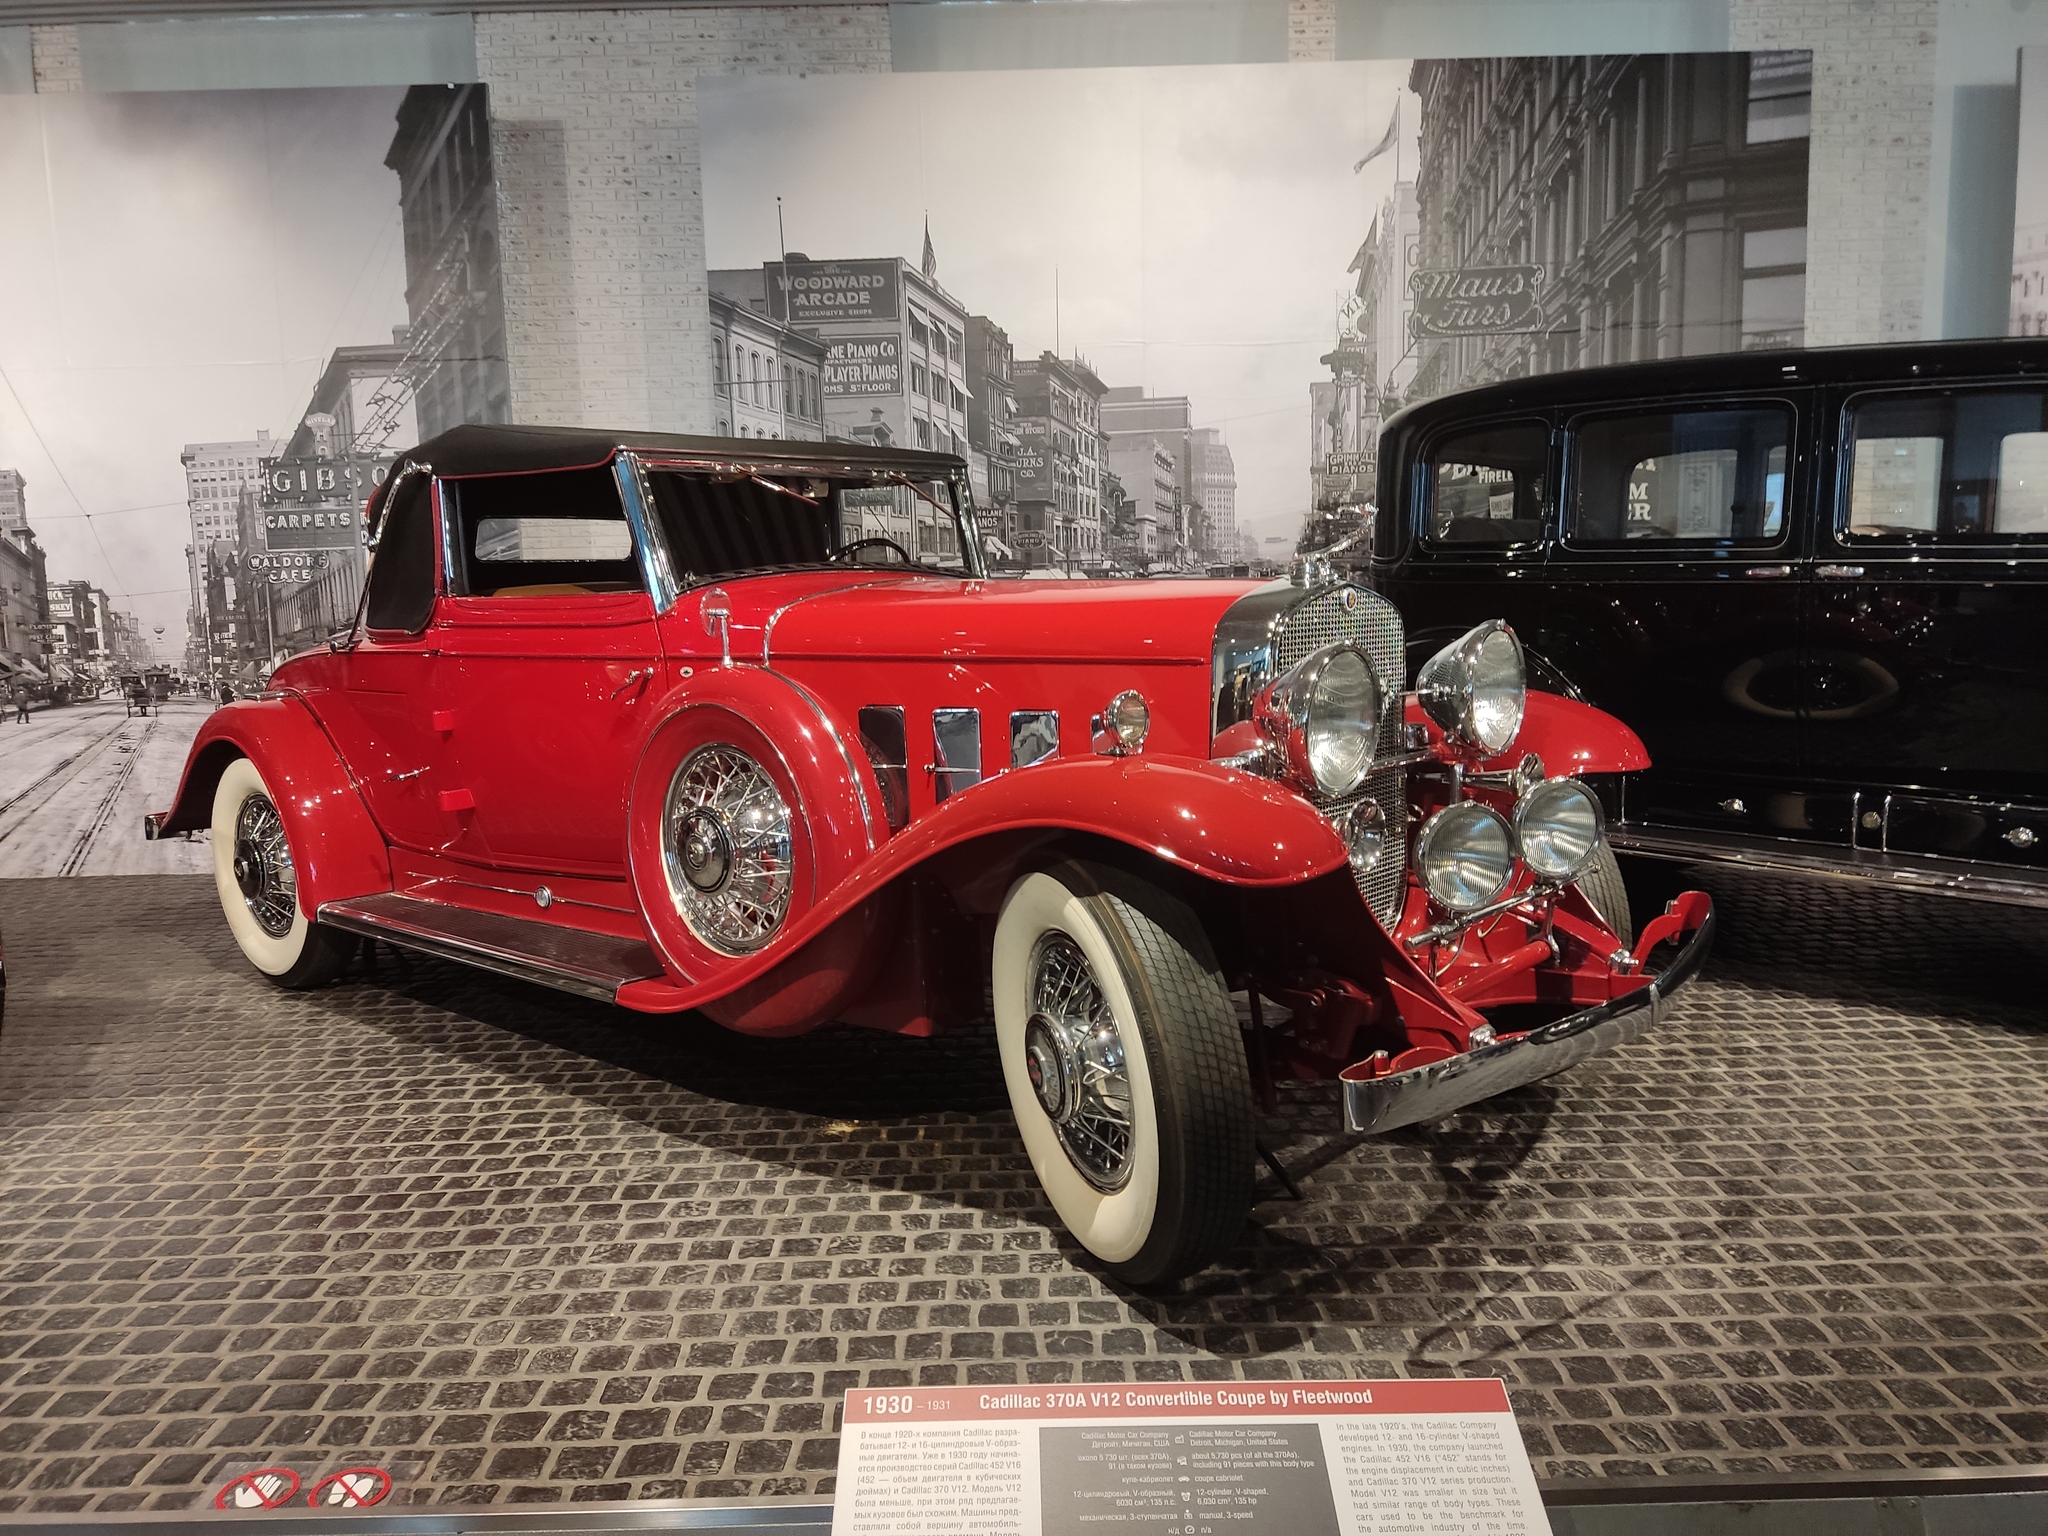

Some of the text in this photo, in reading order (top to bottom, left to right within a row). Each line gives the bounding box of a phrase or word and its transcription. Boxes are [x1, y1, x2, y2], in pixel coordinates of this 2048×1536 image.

[777, 275, 885, 290] WOODWARD
[793, 291, 871, 306] ARCADE
[799, 309, 844, 317] EXCLUSIVE
[847, 342, 879, 358] PIANO
[1332, 465, 1374, 474] PIANOS
[266, 513, 351, 529] CARPETS
[251, 556, 326, 568] WALDORF
[269, 569, 312, 580] CAFE
[863, 1396, 950, 1414] 1930 1931
[980, 1389, 1372, 1409] Cadillac 370A V12 Convertible Coupe by Fleetwood
[1346, 1423, 1360, 1431] the
[1361, 1422, 1377, 1430] late
[1410, 1422, 1424, 1430] the
[1426, 1421, 1458, 1430] Cadillac
[1459, 1420, 1497, 1431] Company
[861, 1428, 1021, 1440] В конце 1920-х компания Cadillac разра-
[1338, 1431, 1500, 1443] developed 12- and 16-cylinder V-shaped
[860, 1442, 896, 1450] батывает
[898, 1441, 910, 1449] 12-
[918, 1440, 985, 1450] 16-цилиндровые
[986, 1439, 1021, 1448] V-образ-
[1340, 1442, 1504, 1454] engines. In 1930, the company launched
[876, 1453, 920, 1462] двигатели.
[922, 1451, 939, 1460] Уже
[948, 1450, 968, 1459] 1930
[969, 1452, 989, 1460] году
[990, 1451, 1022, 1462] начина-
[1343, 1456, 1356, 1464] the
[1360, 1455, 1392, 1463] Cadillac
[1395, 1454, 1411, 1463] 452
[1414, 1454, 1431, 1463] V16
[1464, 1453, 1492, 1462] stands
[1494, 1453, 1506, 1461] for
[876, 1464, 933, 1474] производство
[933, 1462, 958, 1472] серий
[958, 1461, 989, 1470] Cadillac
[989, 1461, 1005, 1470] 452
[1005, 1460, 1022, 1469] V16
[1345, 1464, 1510, 1476] the engine displacement in cubic inches)
[1349, 1475, 1514, 1486] and Cadillac 370 V12 series production.
[1350, 1489, 1376, 1498] Model
[1381, 1489, 1397, 1497] V12
[1424, 1488, 1453, 1497] smaller
[1472, 1487, 1488, 1496] size
[1493, 1487, 1507, 1495] but
[854, 1496, 1022, 1508] была меньше, при этом ряд предлагае-
[1353, 1498, 1521, 1510] had similar range of body types. These
[1380, 1512, 1400, 1521] used
[1407, 1512, 1416, 1520] to
[1422, 1511, 1433, 1520] be
[1439, 1511, 1453, 1520] the
[1460, 1510, 1506, 1519] benchmark
[1512, 1509, 1523, 1518] for
[1357, 1524, 1371, 1533] the
[1378, 1524, 1424, 1533] automotive
[1431, 1522, 1465, 1533] industry
[1472, 1522, 1480, 1531] of
[1486, 1522, 1500, 1530] the
[1506, 1521, 1528, 1530] time.
